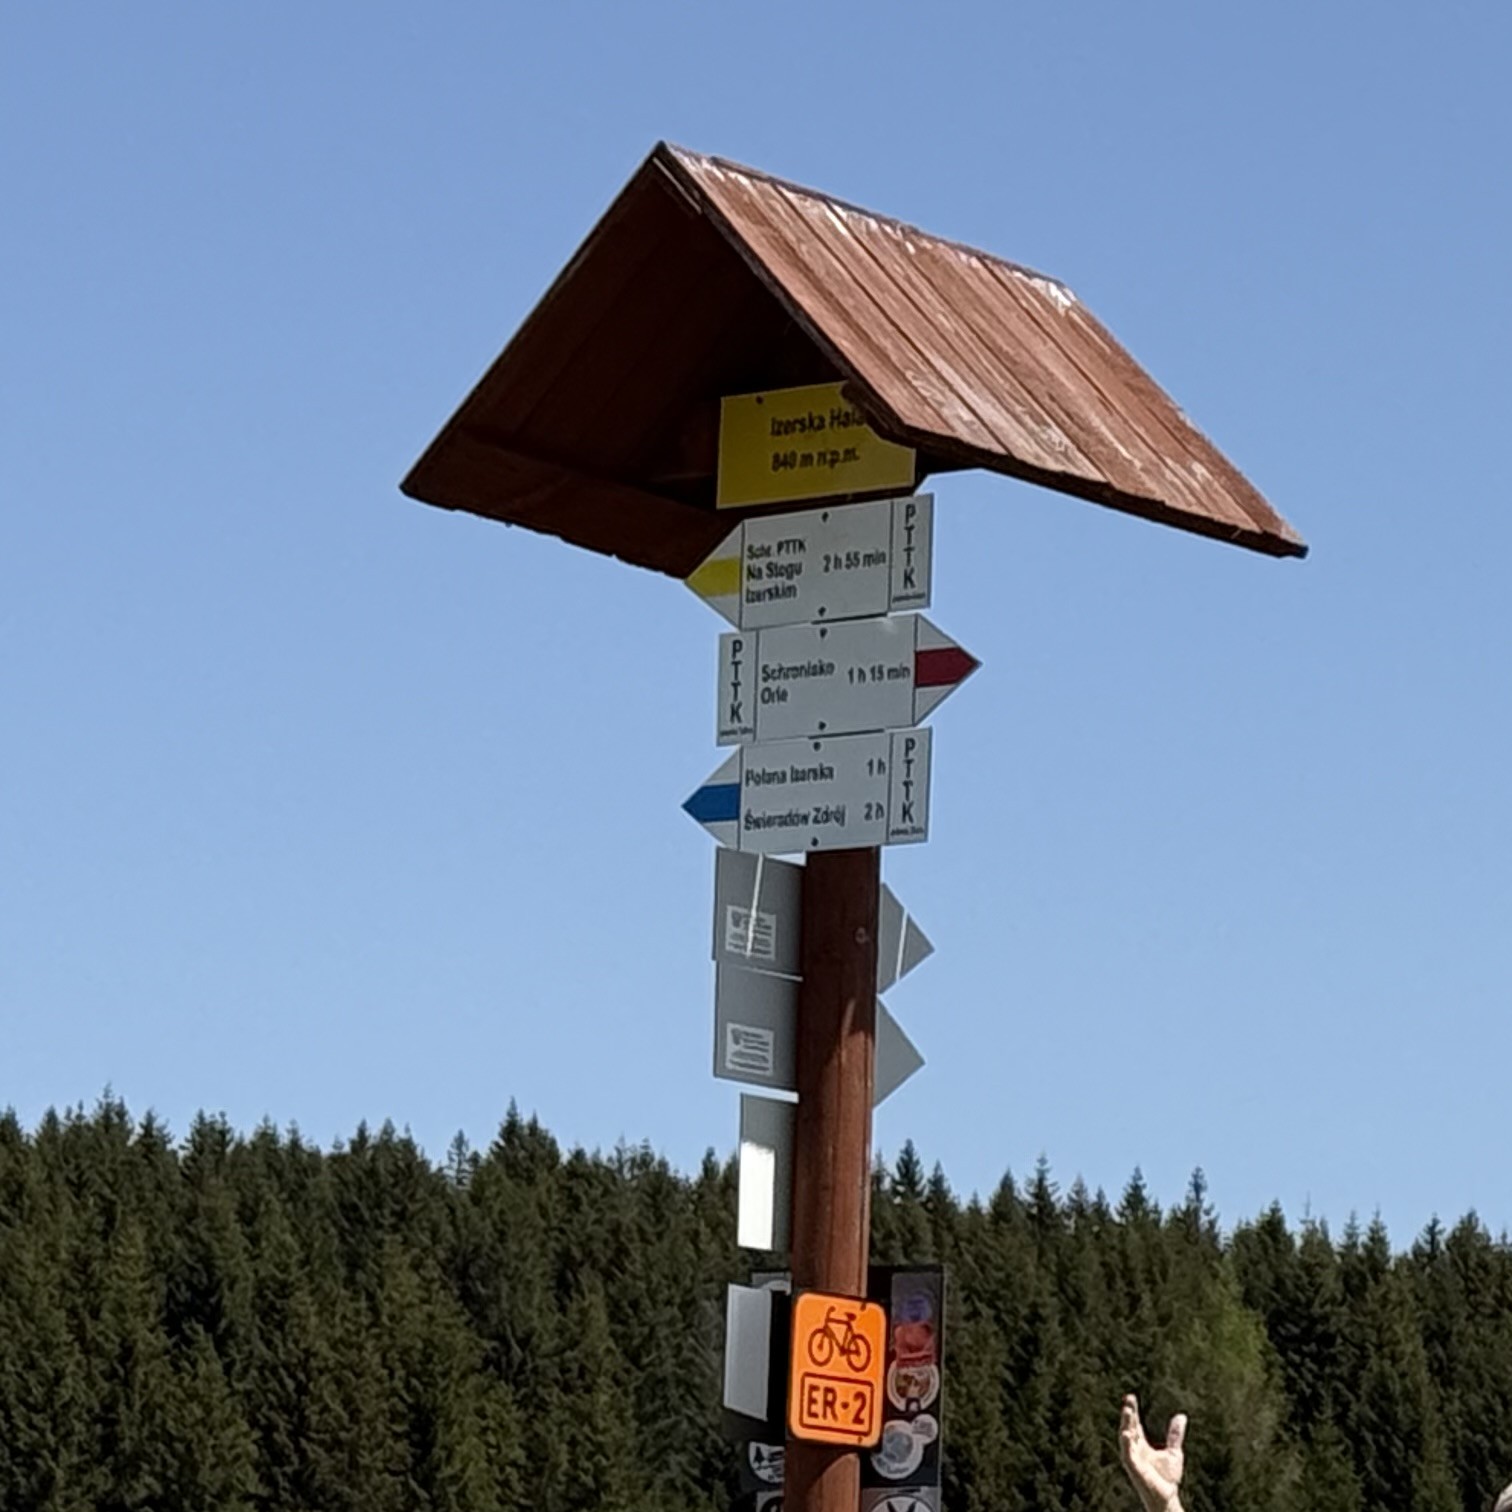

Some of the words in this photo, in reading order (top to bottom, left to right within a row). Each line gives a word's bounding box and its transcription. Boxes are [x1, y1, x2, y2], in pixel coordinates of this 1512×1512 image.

[771, 411, 825, 437] Izerska
[772, 451, 797, 472] 840
[799, 452, 814, 467] m
[776, 539, 806, 556] PTTK
[903, 503, 917, 589] PTTK
[822, 554, 831, 573] 2
[833, 553, 843, 571] h
[844, 551, 861, 569] 55
[862, 548, 887, 567] min
[746, 565, 763, 581] Na
[745, 583, 797, 604] Izerskim
[729, 639, 744, 724] PTTK
[761, 658, 835, 683] Schronisko
[847, 666, 855, 685] 1
[857, 666, 867, 683] h
[870, 665, 885, 682] 15
[887, 662, 911, 680] min
[761, 686, 788, 705] Orle
[745, 766, 787, 787] Polana
[866, 758, 874, 777] 1
[877, 757, 887, 775] h
[901, 738, 916, 824] PTTK
[744, 808, 811, 830] Świeradów
[812, 804, 846, 827] Zdrój
[863, 803, 874, 821] 2
[875, 802, 885, 820] h
